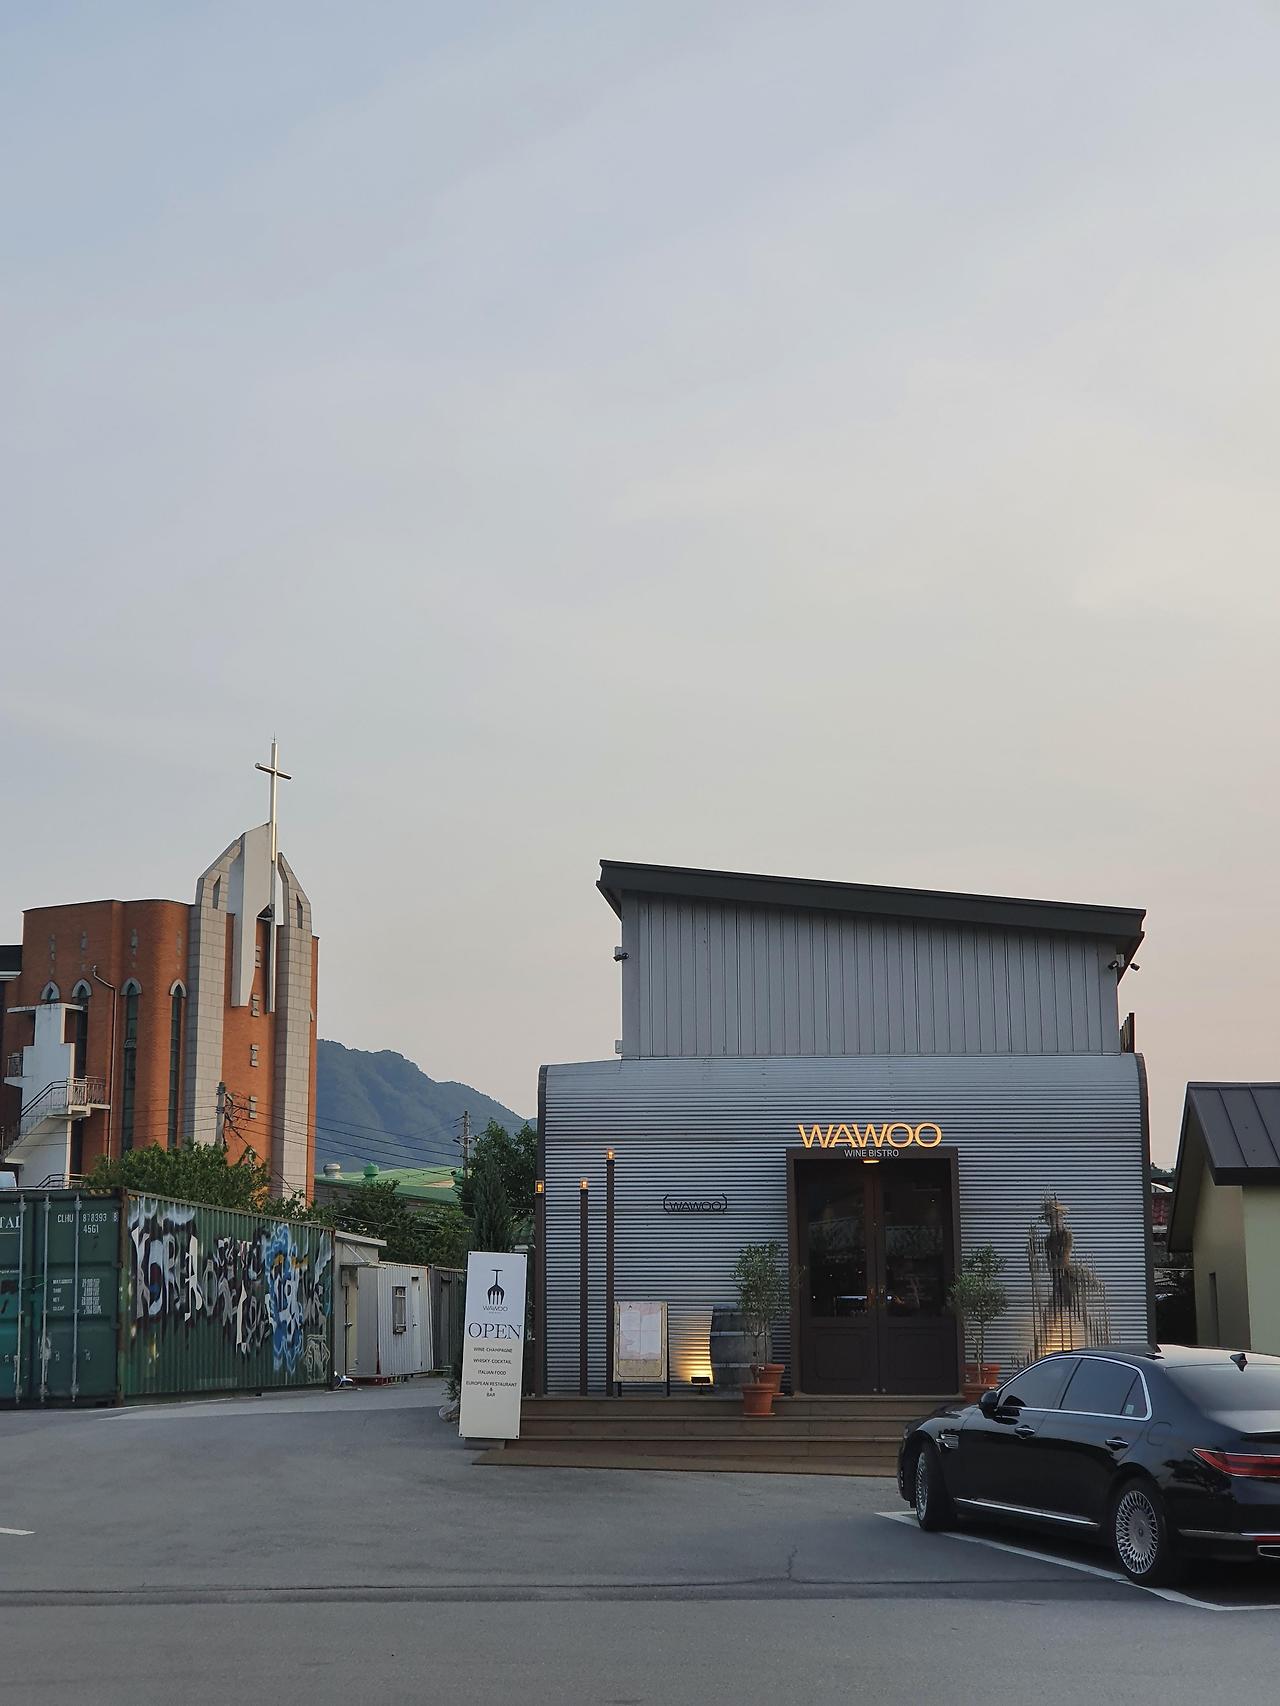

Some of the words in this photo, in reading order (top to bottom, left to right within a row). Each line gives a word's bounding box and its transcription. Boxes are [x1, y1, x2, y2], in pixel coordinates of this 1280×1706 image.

[798, 1122, 942, 1149] WAWOO
[844, 1149, 867, 1158] WINE
[868, 1149, 900, 1158] BISTRO
[669, 1201, 722, 1212] WAWOO
[468, 1322, 523, 1340] OPEN
